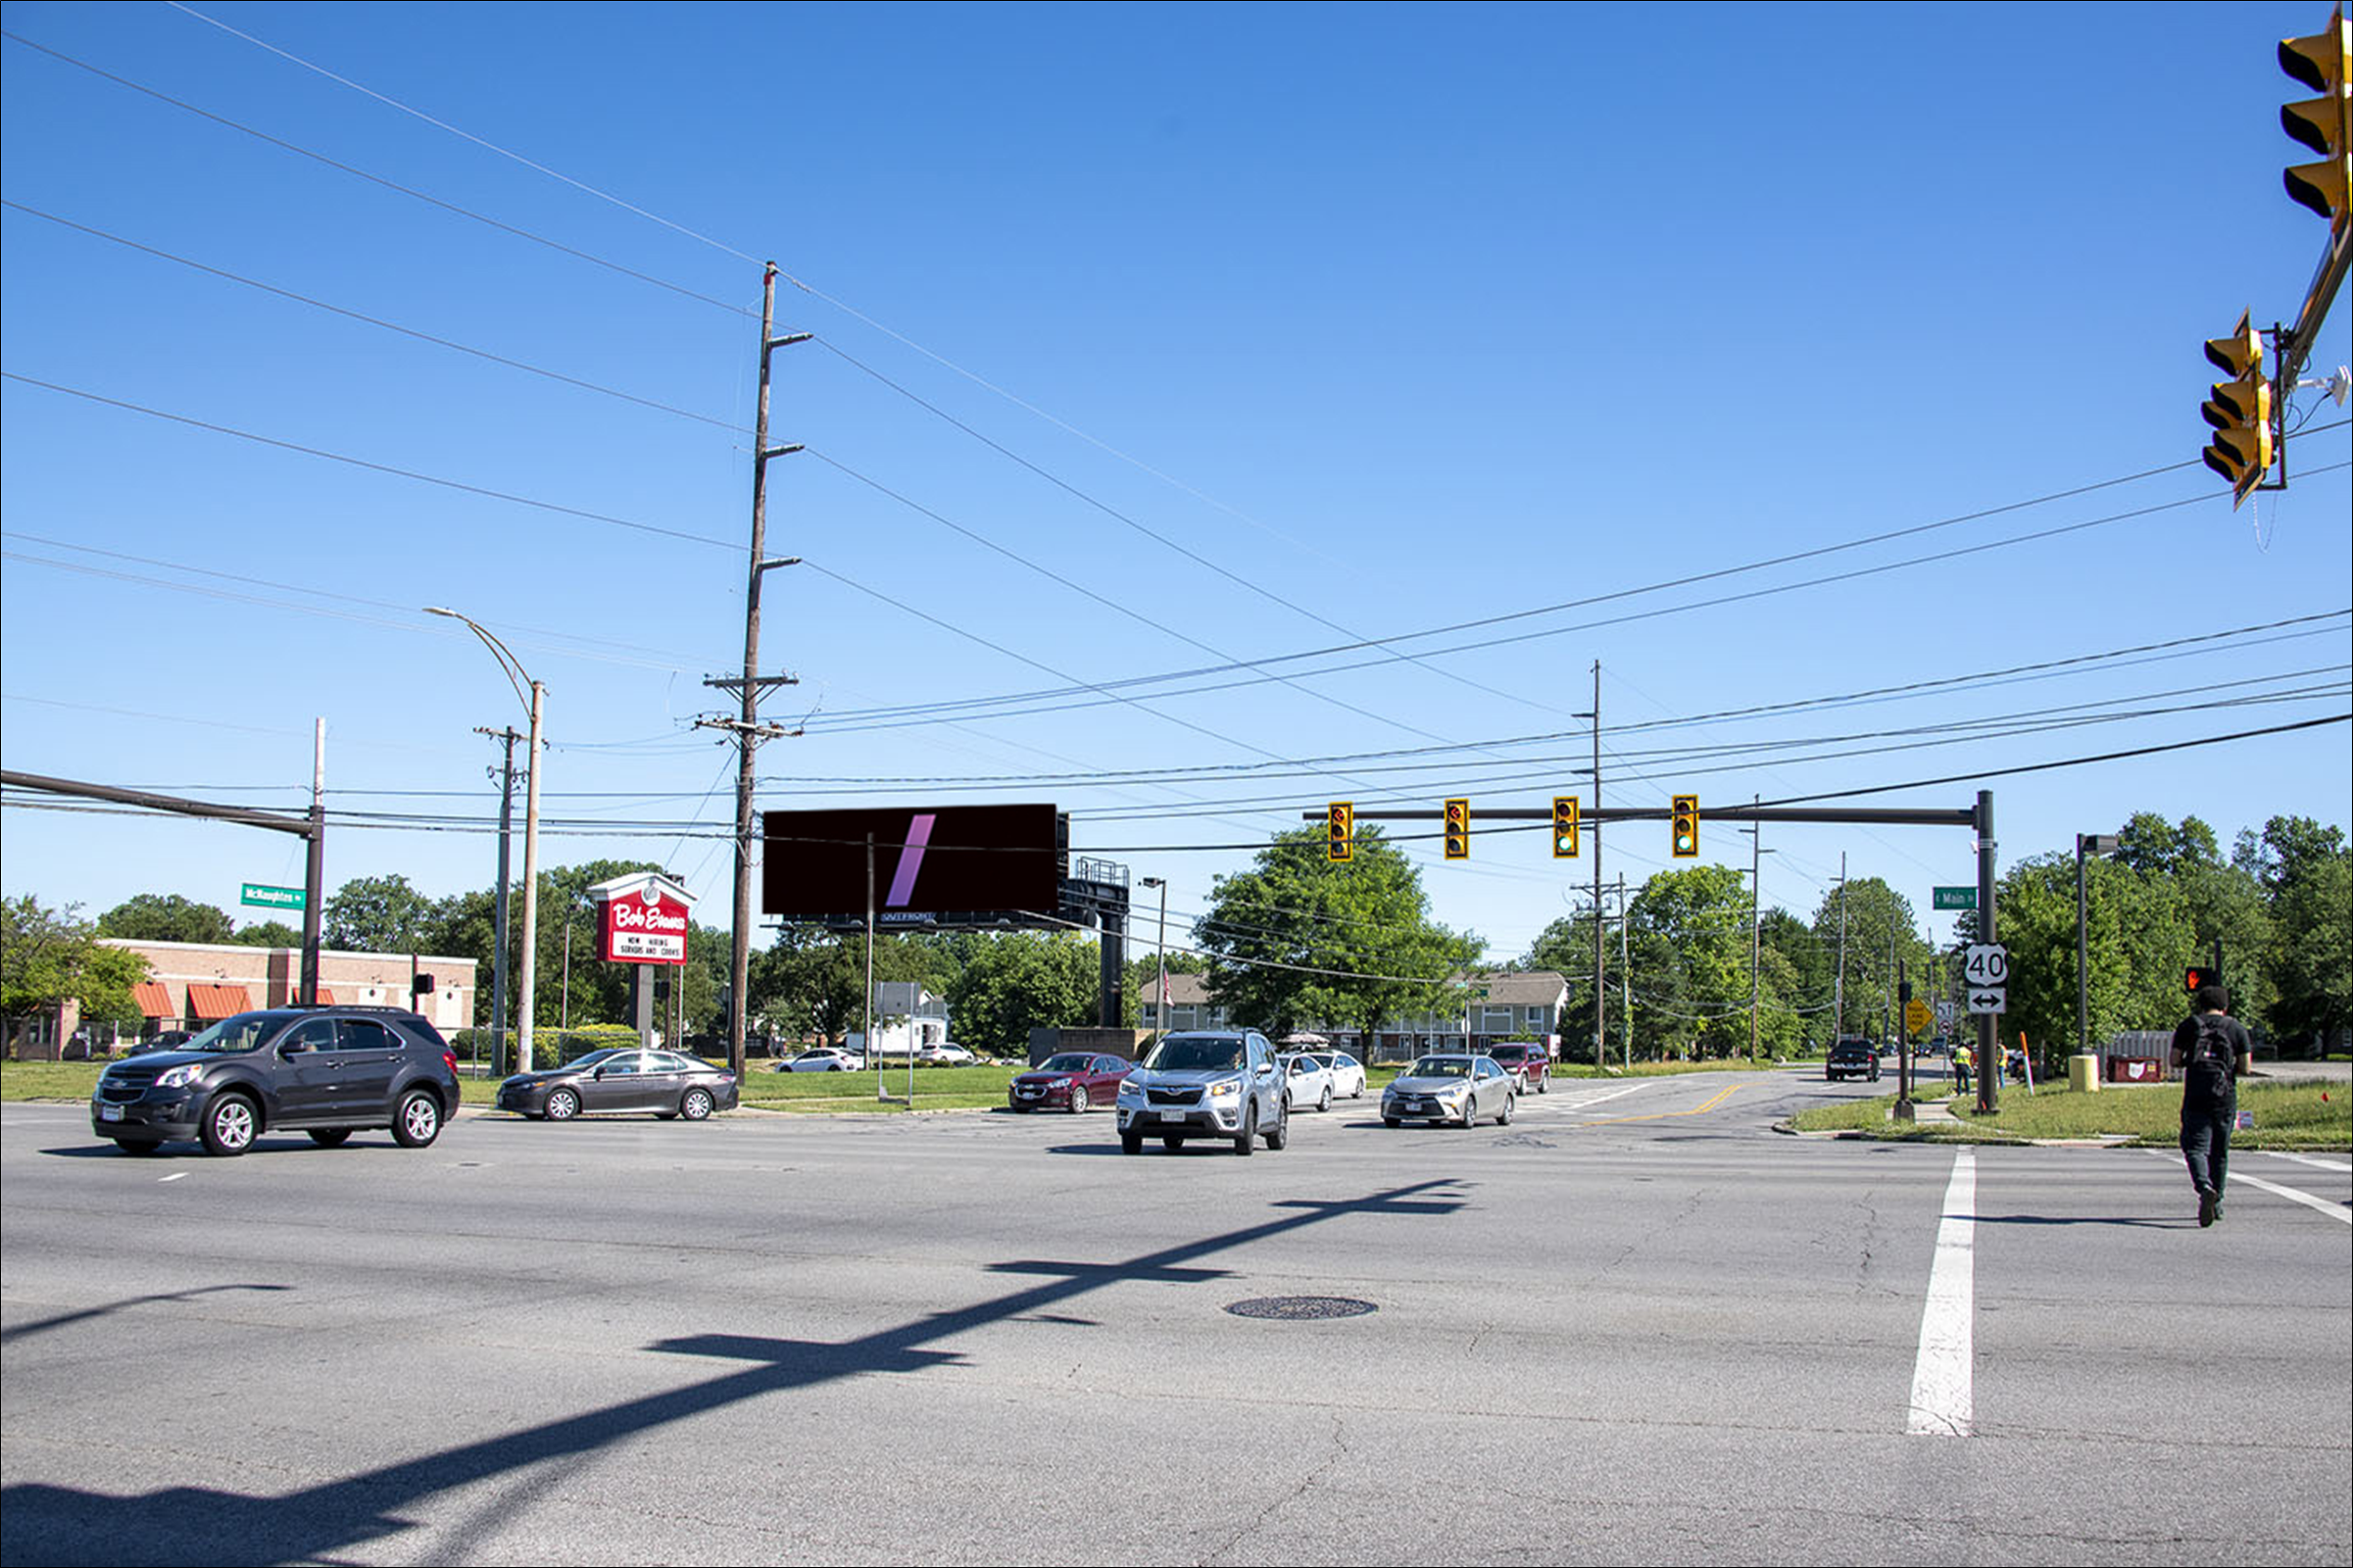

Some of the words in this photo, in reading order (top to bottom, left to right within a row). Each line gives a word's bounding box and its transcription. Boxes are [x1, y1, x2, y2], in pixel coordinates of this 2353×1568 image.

[1942, 892, 1966, 904] Main
[613, 903, 646, 928] Bob
[645, 907, 686, 930] Evans
[1969, 953, 2004, 978] 40
